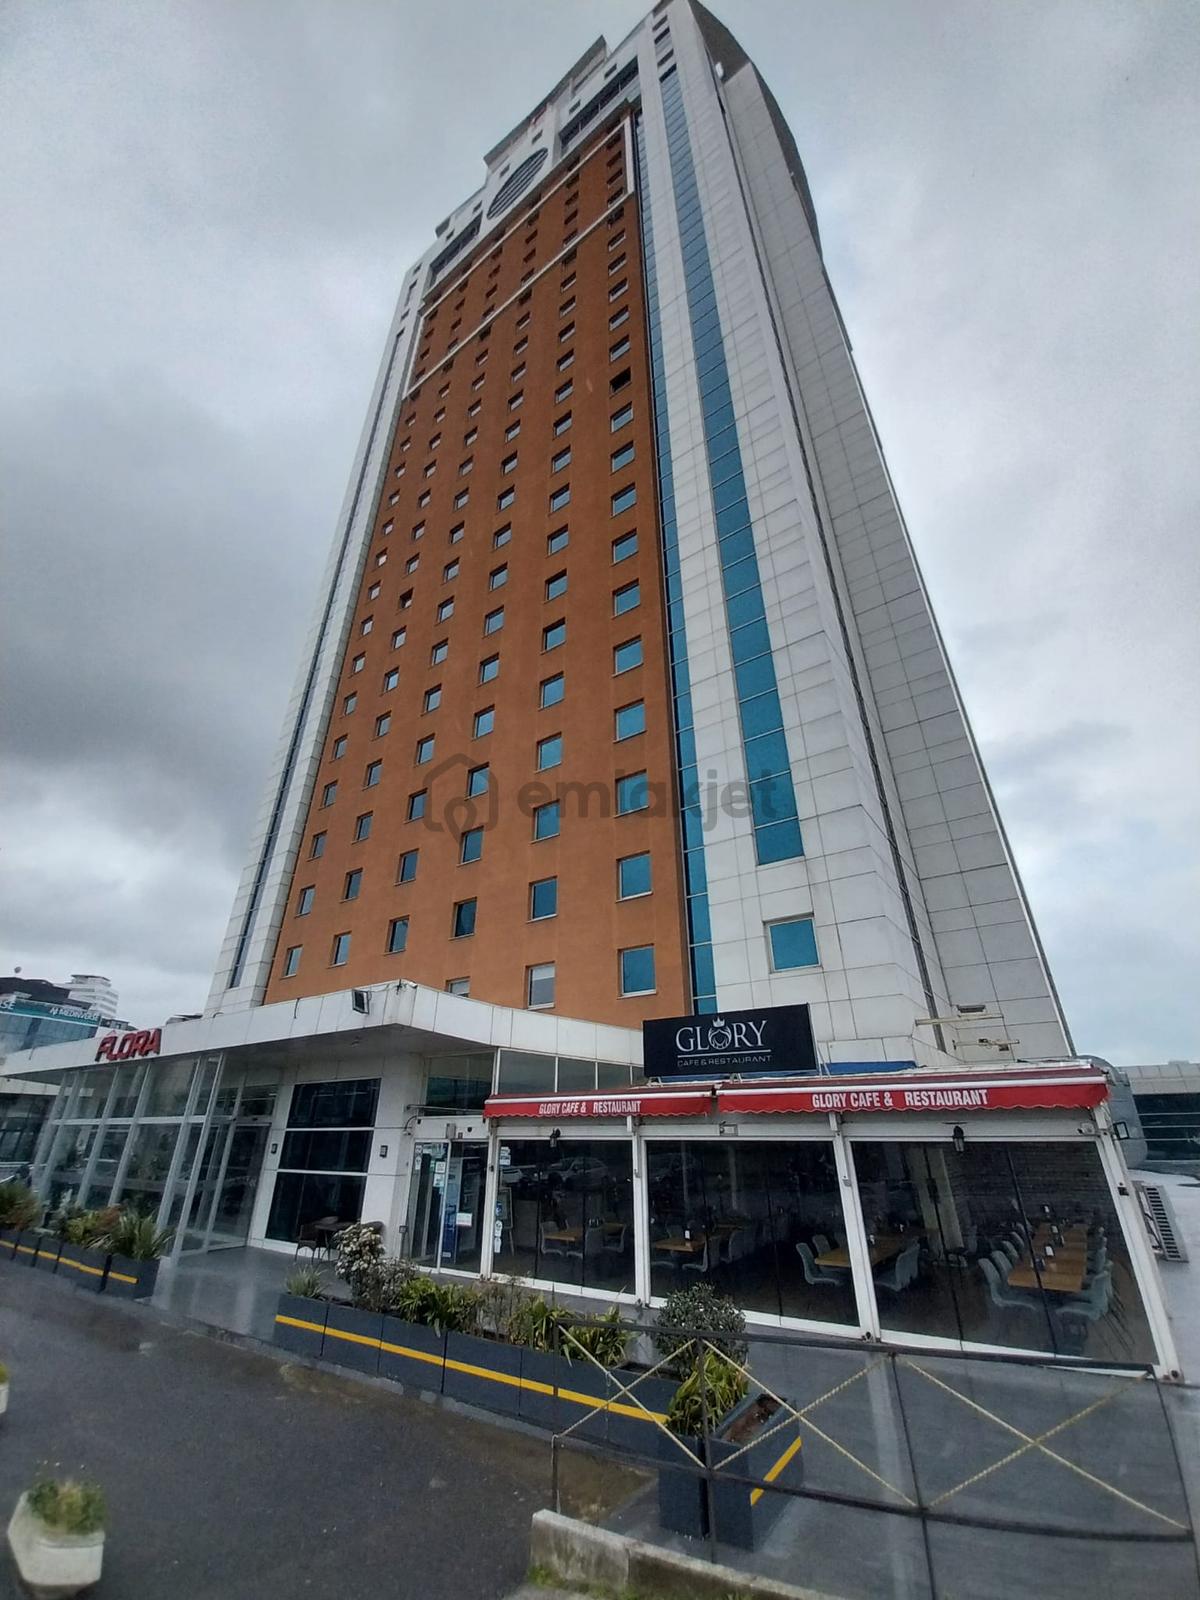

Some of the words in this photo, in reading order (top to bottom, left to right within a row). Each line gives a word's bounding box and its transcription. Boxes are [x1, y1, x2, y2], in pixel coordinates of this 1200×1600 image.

[0, 1000, 16, 1010] SE
[675, 1019, 768, 1052] GLORY
[95, 1028, 162, 1062] FLORA
[677, 1059, 700, 1067] CAFE
[708, 1055, 772, 1065] RESTAURANT
[811, 1093, 847, 1108] GLORY
[850, 1092, 881, 1107] CAFE
[884, 1092, 893, 1106] &
[904, 1089, 988, 1106] RESTAURANT
[539, 1103, 561, 1115] GLORY
[562, 1102, 579, 1114] CAFE
[581, 1101, 587, 1113] &
[593, 1100, 642, 1113] RESTAURANT
